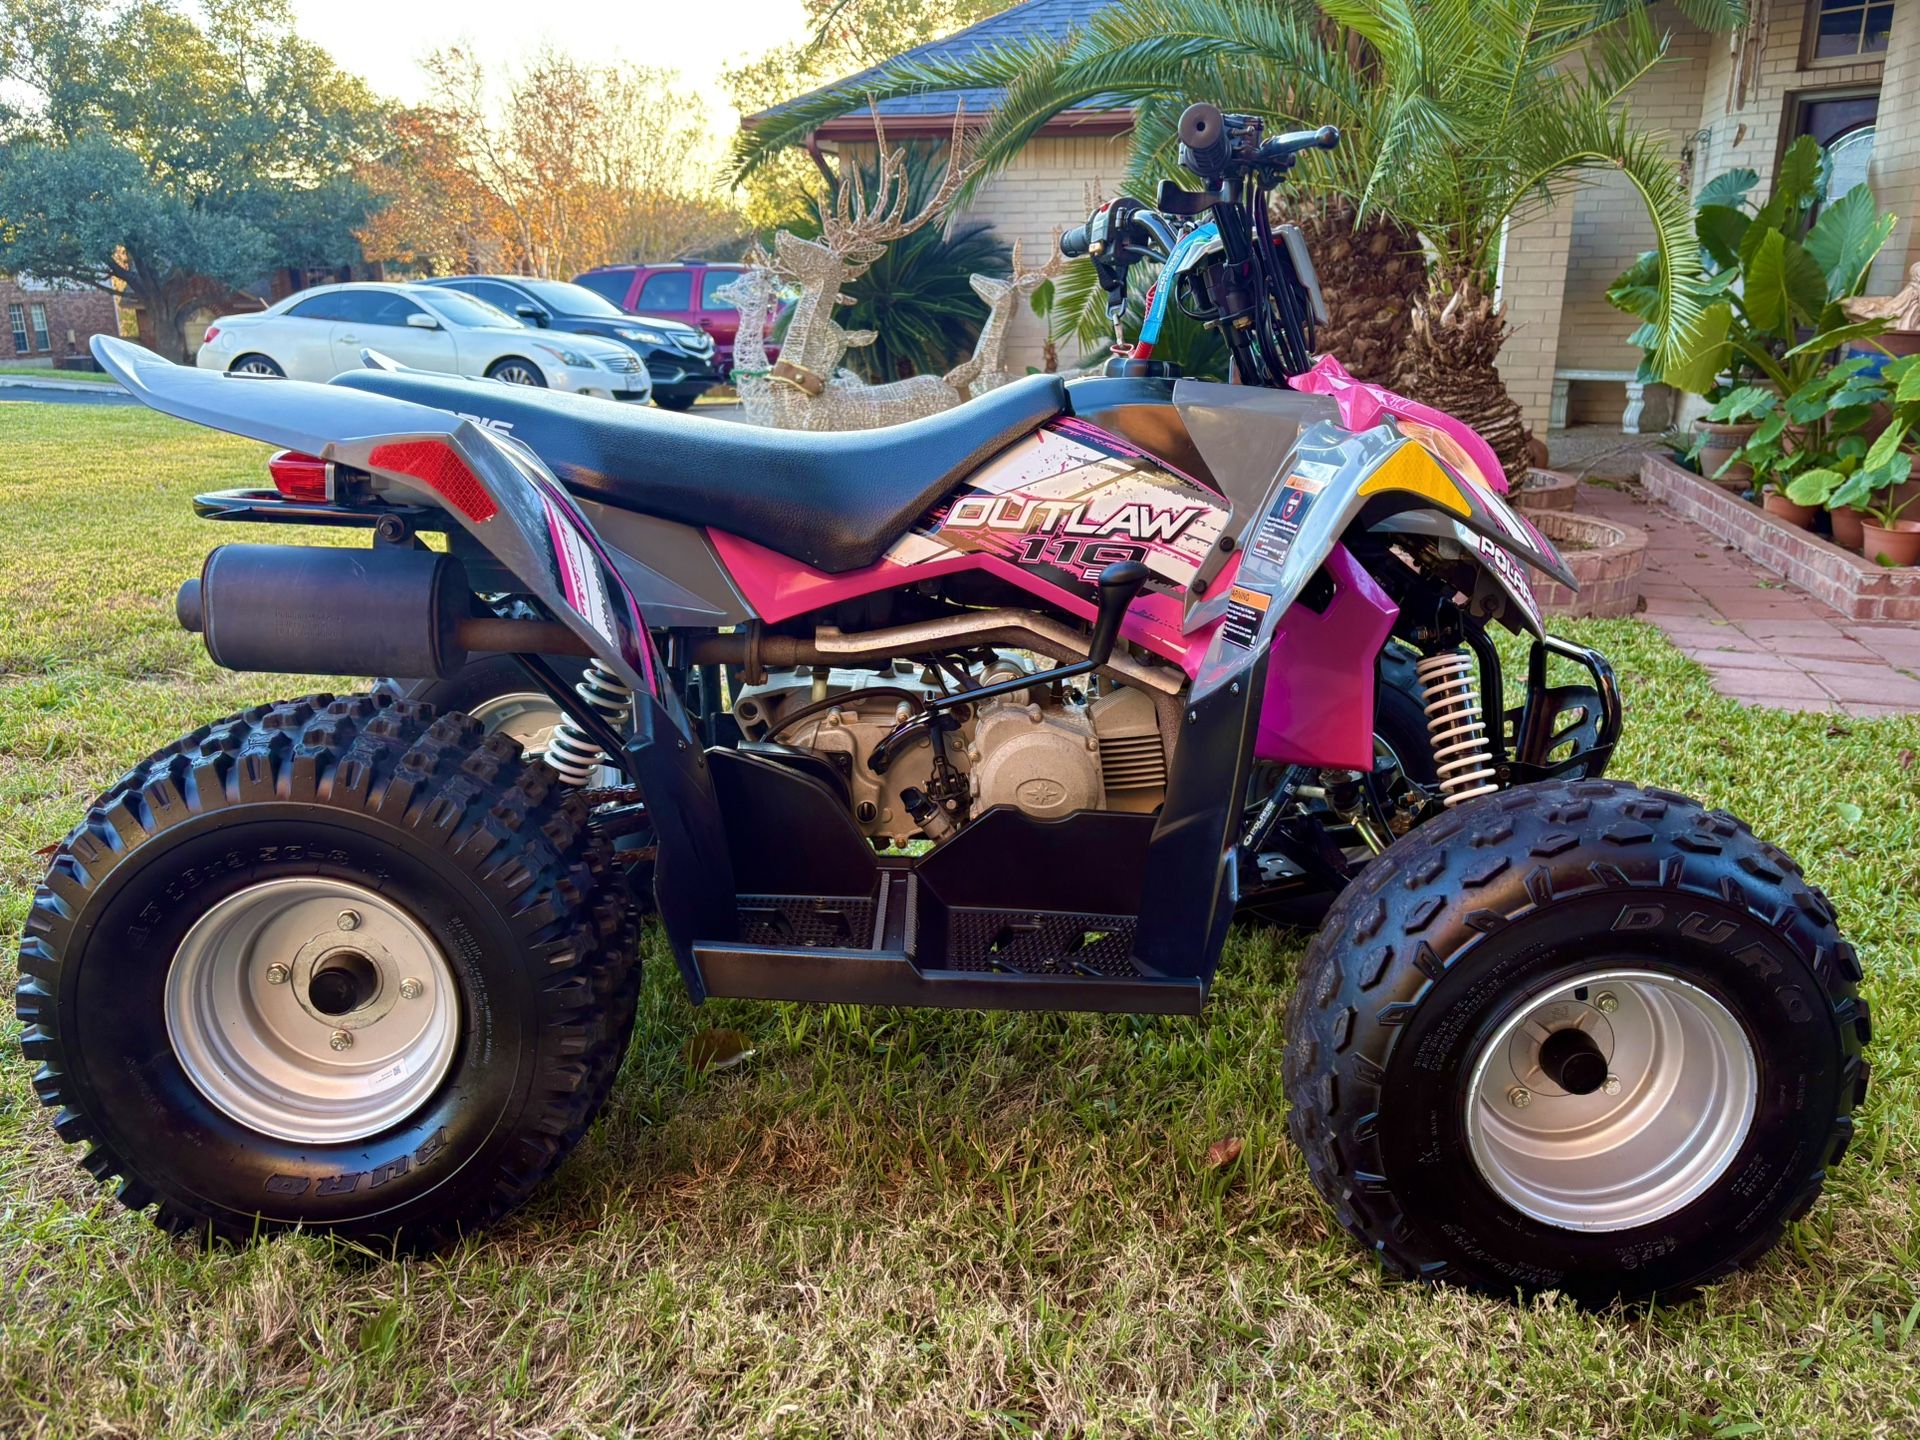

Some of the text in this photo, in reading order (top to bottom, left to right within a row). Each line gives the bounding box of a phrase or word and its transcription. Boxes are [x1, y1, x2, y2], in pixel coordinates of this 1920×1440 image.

[943, 496, 1206, 543] OUTLAW
[1019, 536, 1149, 570] 110
[1249, 798, 1274, 836] POLARIS
[1609, 903, 1813, 1023] DURO
[263, 1125, 448, 1196] DURO
